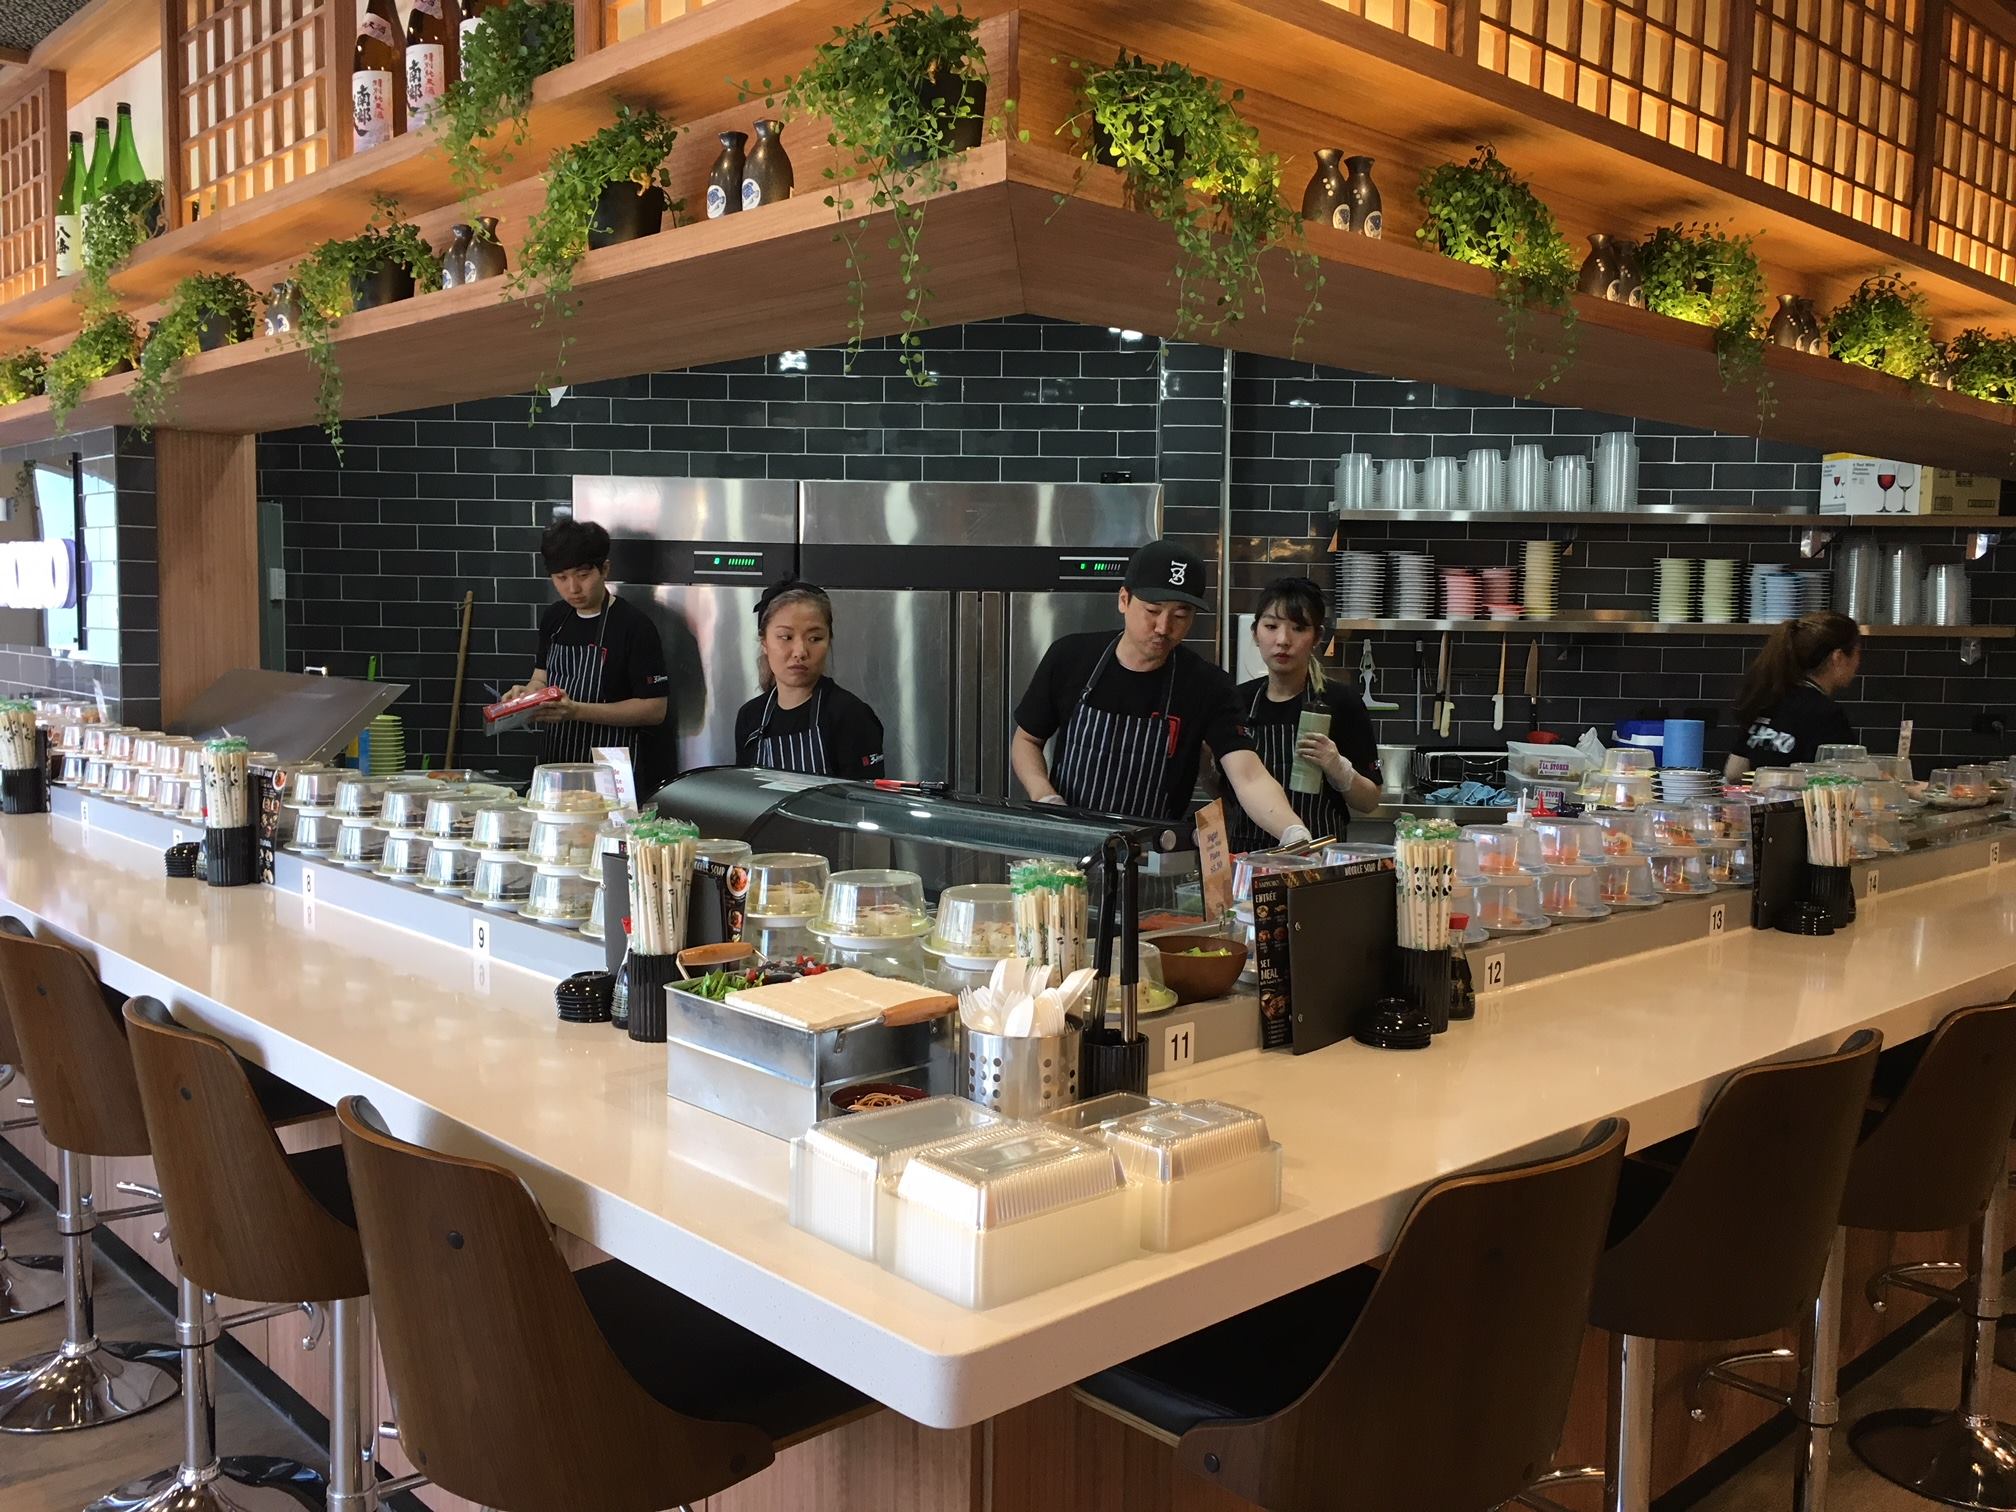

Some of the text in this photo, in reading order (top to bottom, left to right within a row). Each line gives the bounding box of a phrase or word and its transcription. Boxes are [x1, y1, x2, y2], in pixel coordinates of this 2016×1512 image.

[307, 874, 311, 893] 8
[1255, 891, 1277, 904] ENTRÉE
[1712, 910, 1722, 930] 13
[478, 926, 484, 948] 9
[1260, 959, 1270, 968] SET
[1488, 961, 1501, 985] 12
[1260, 968, 1279, 980] MEAL
[1171, 1031, 1188, 1061] 11
